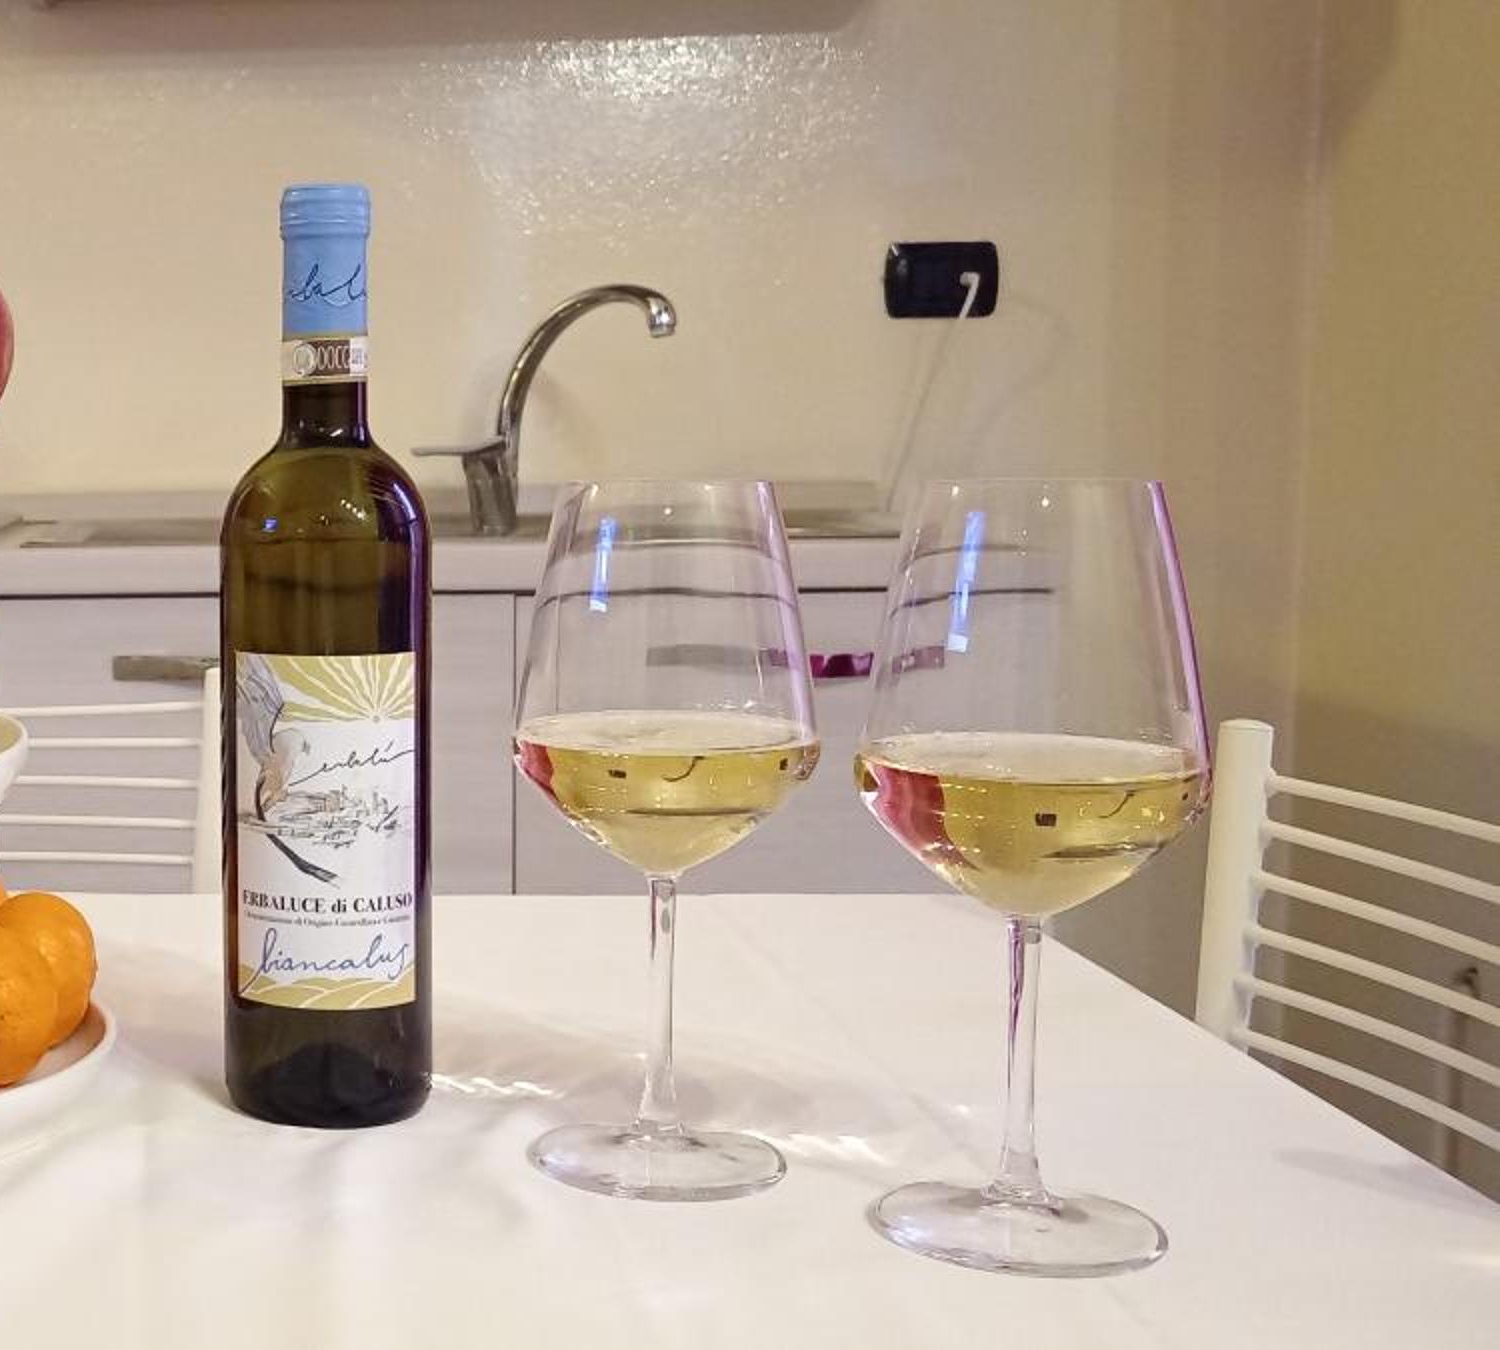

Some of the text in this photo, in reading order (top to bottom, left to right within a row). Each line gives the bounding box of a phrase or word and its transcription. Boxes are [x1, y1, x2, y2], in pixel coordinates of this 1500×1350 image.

[243, 889, 413, 914] ERBALUCE di CALUSO
